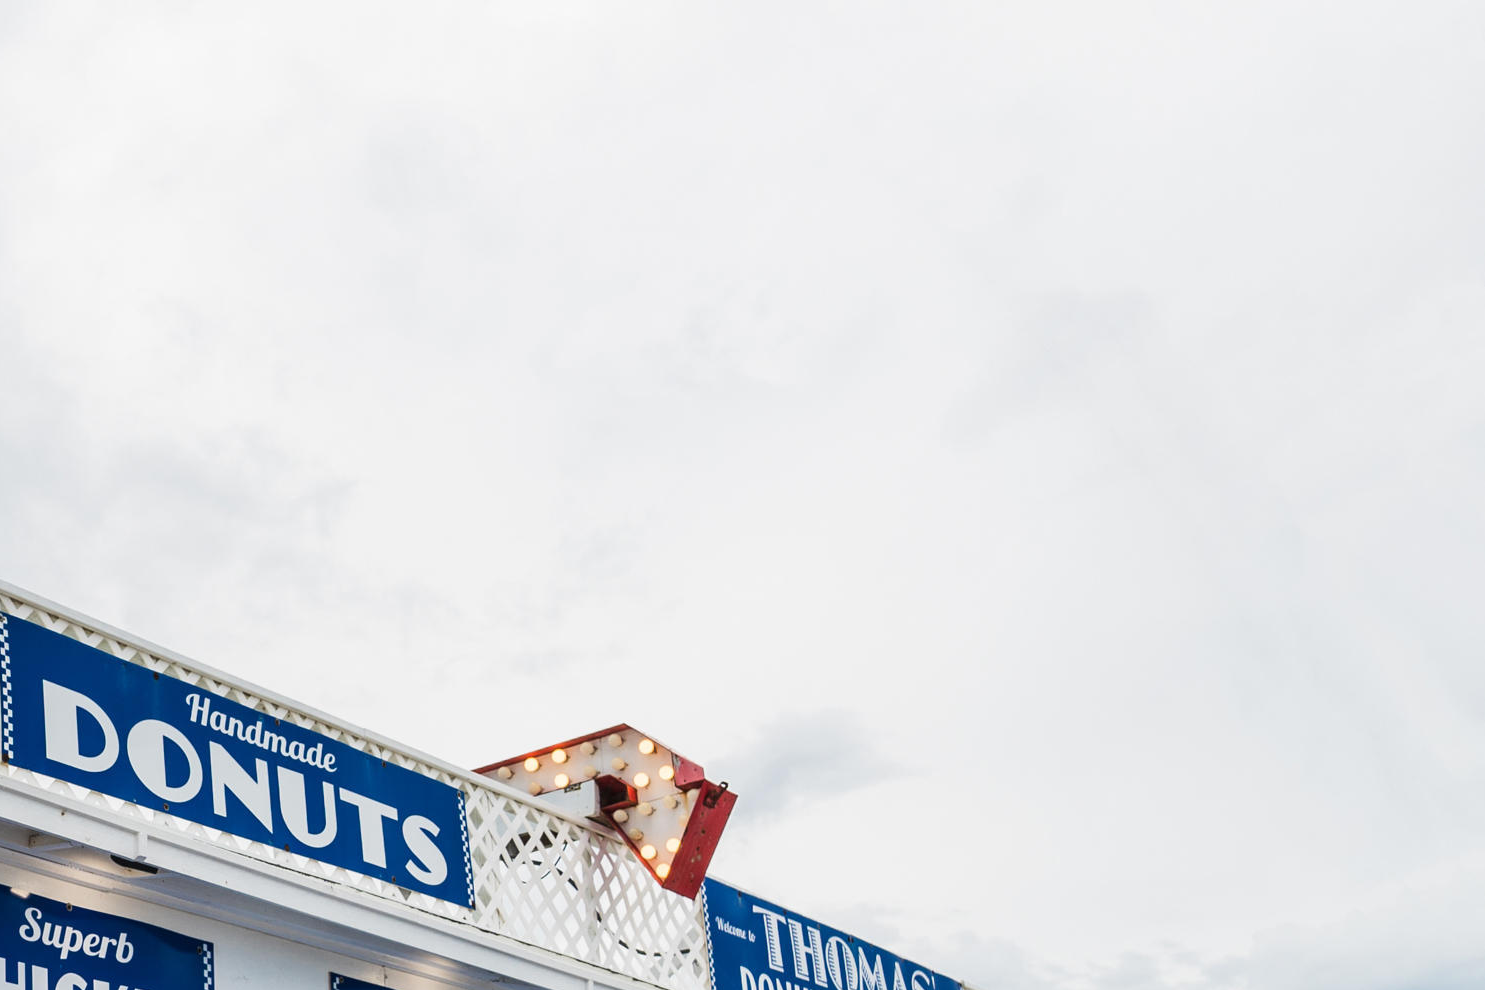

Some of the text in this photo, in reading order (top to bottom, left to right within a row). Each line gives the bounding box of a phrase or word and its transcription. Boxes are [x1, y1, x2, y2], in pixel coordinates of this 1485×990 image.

[185, 693, 338, 773] Handmade
[42, 679, 448, 886] DONUTS
[19, 907, 134, 964] Superb
[715, 916, 756, 943] Welcome to
